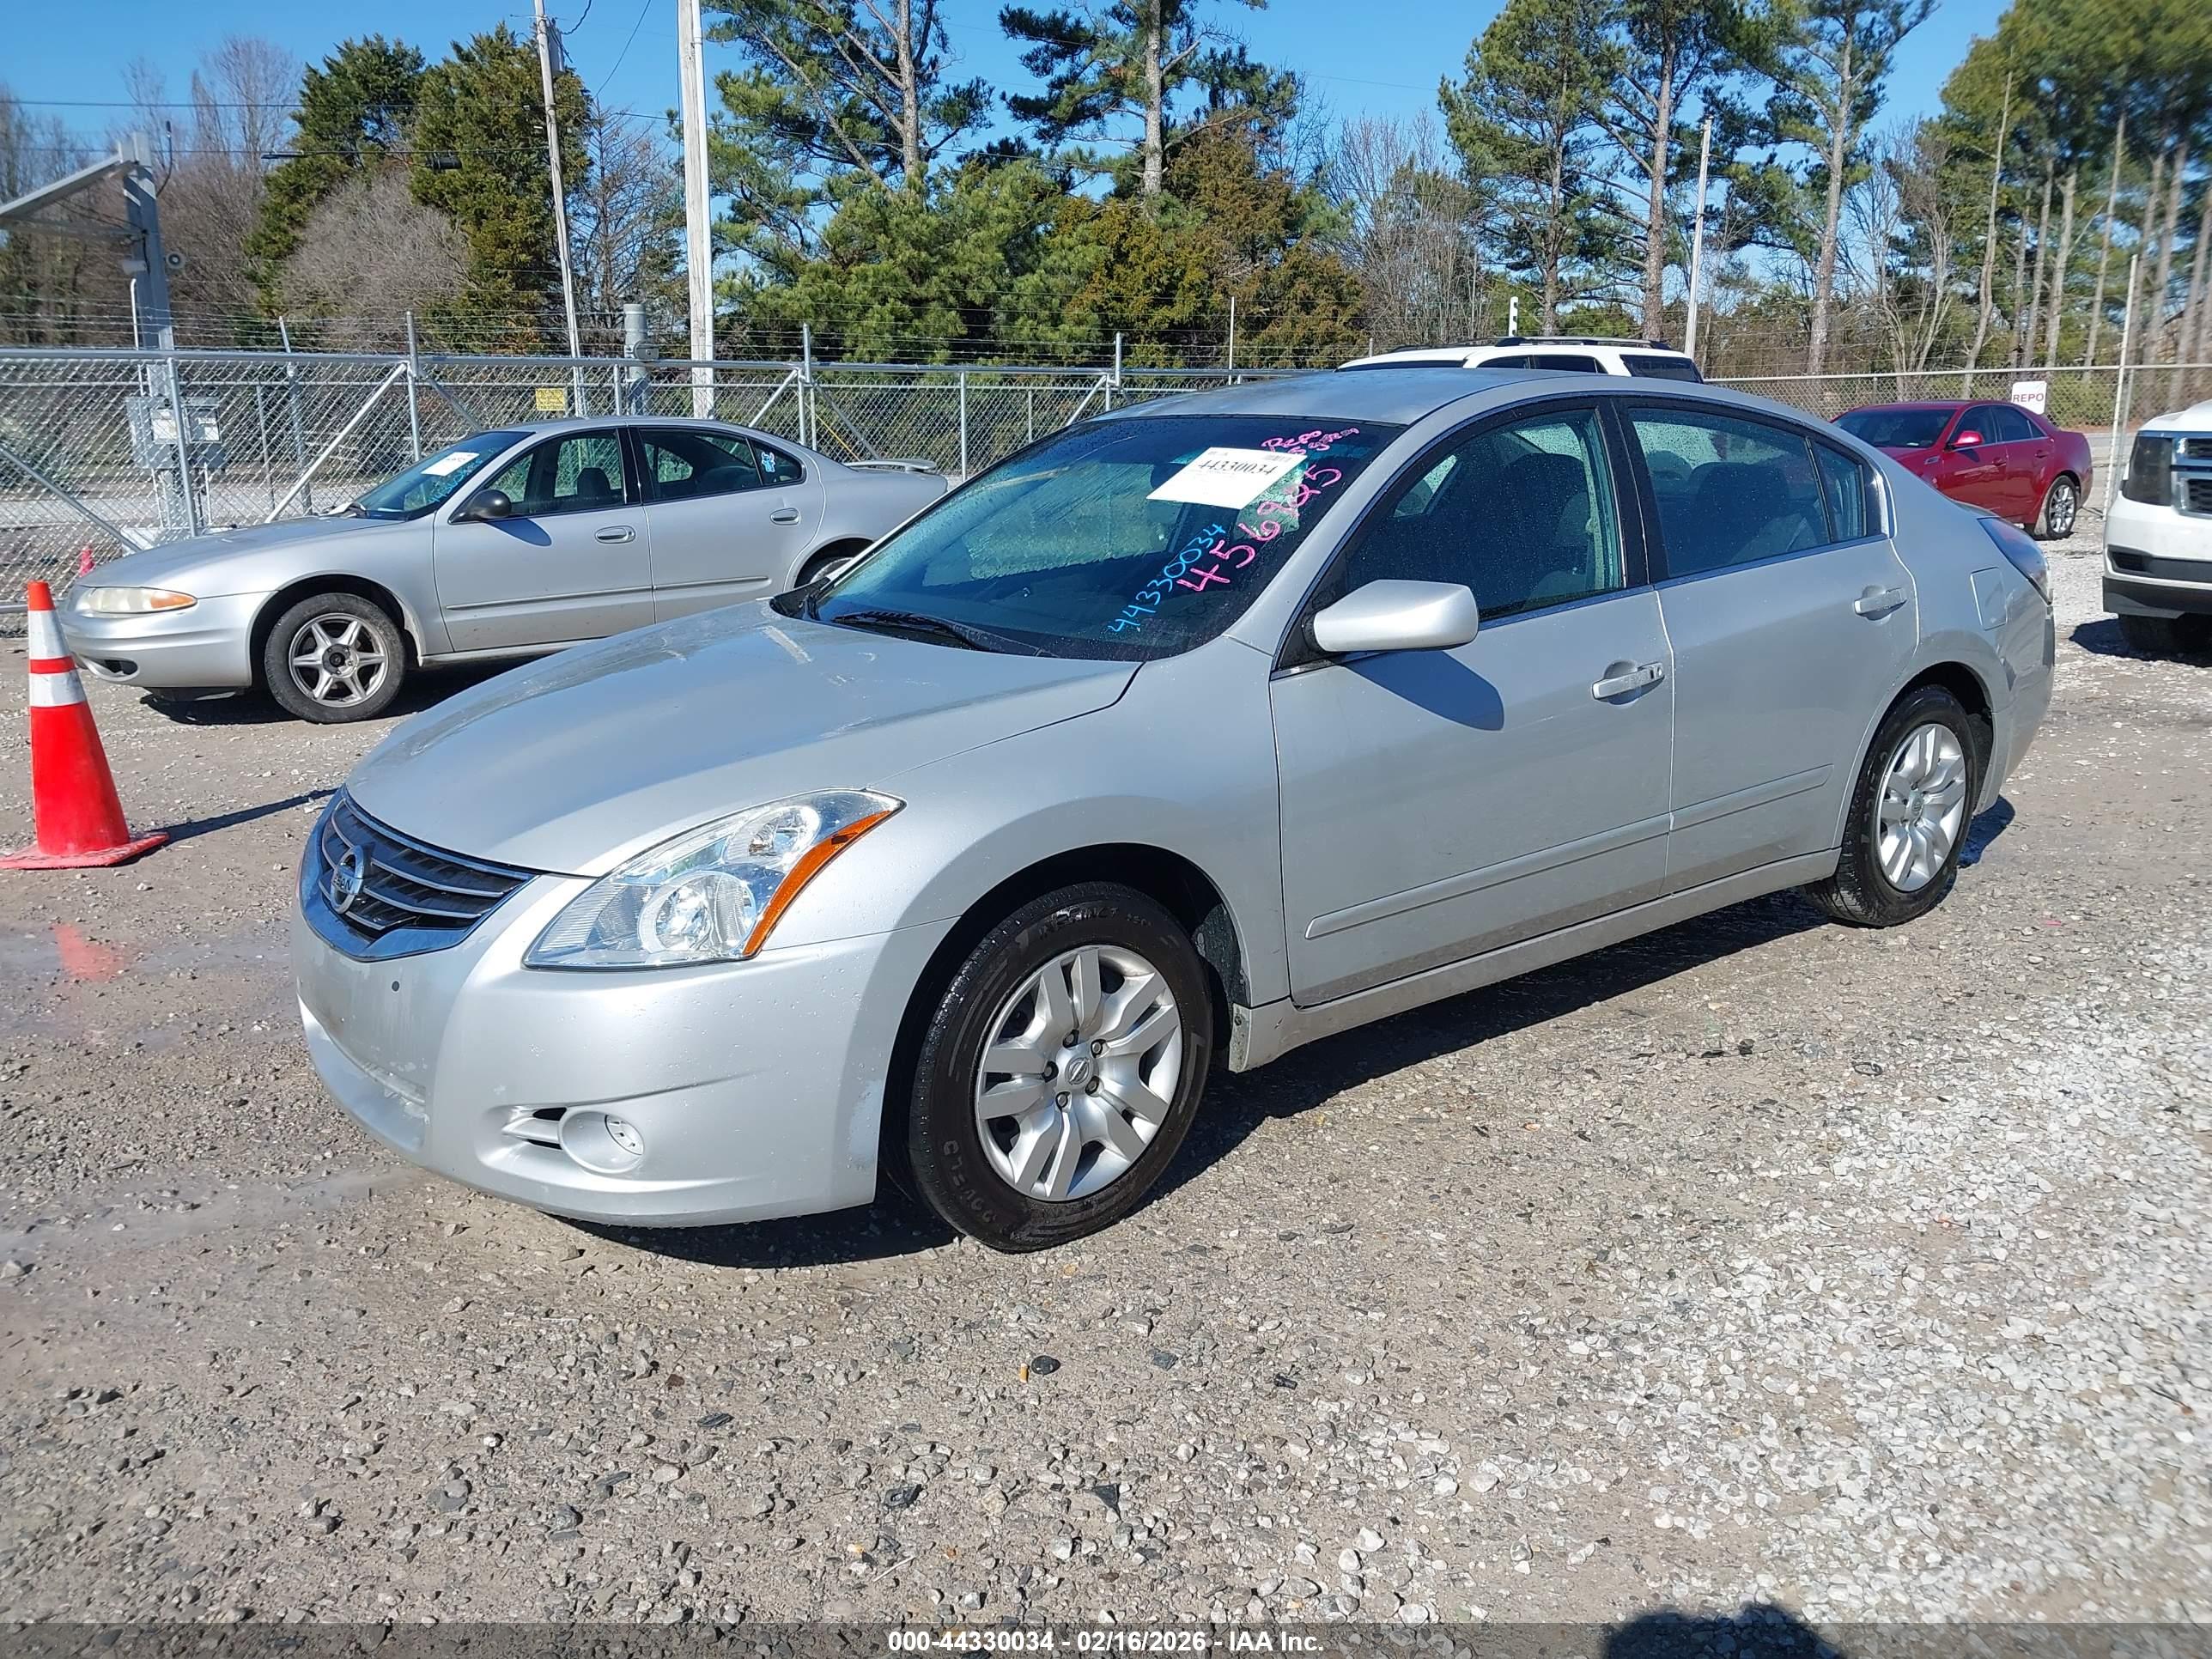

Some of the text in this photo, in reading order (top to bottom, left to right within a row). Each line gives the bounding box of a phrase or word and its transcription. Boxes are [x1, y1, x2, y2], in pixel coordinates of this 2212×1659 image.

[2013, 393, 2044, 403] REPO
[1198, 460, 1278, 475] 44330034
[1108, 524, 1226, 633] 44330034
